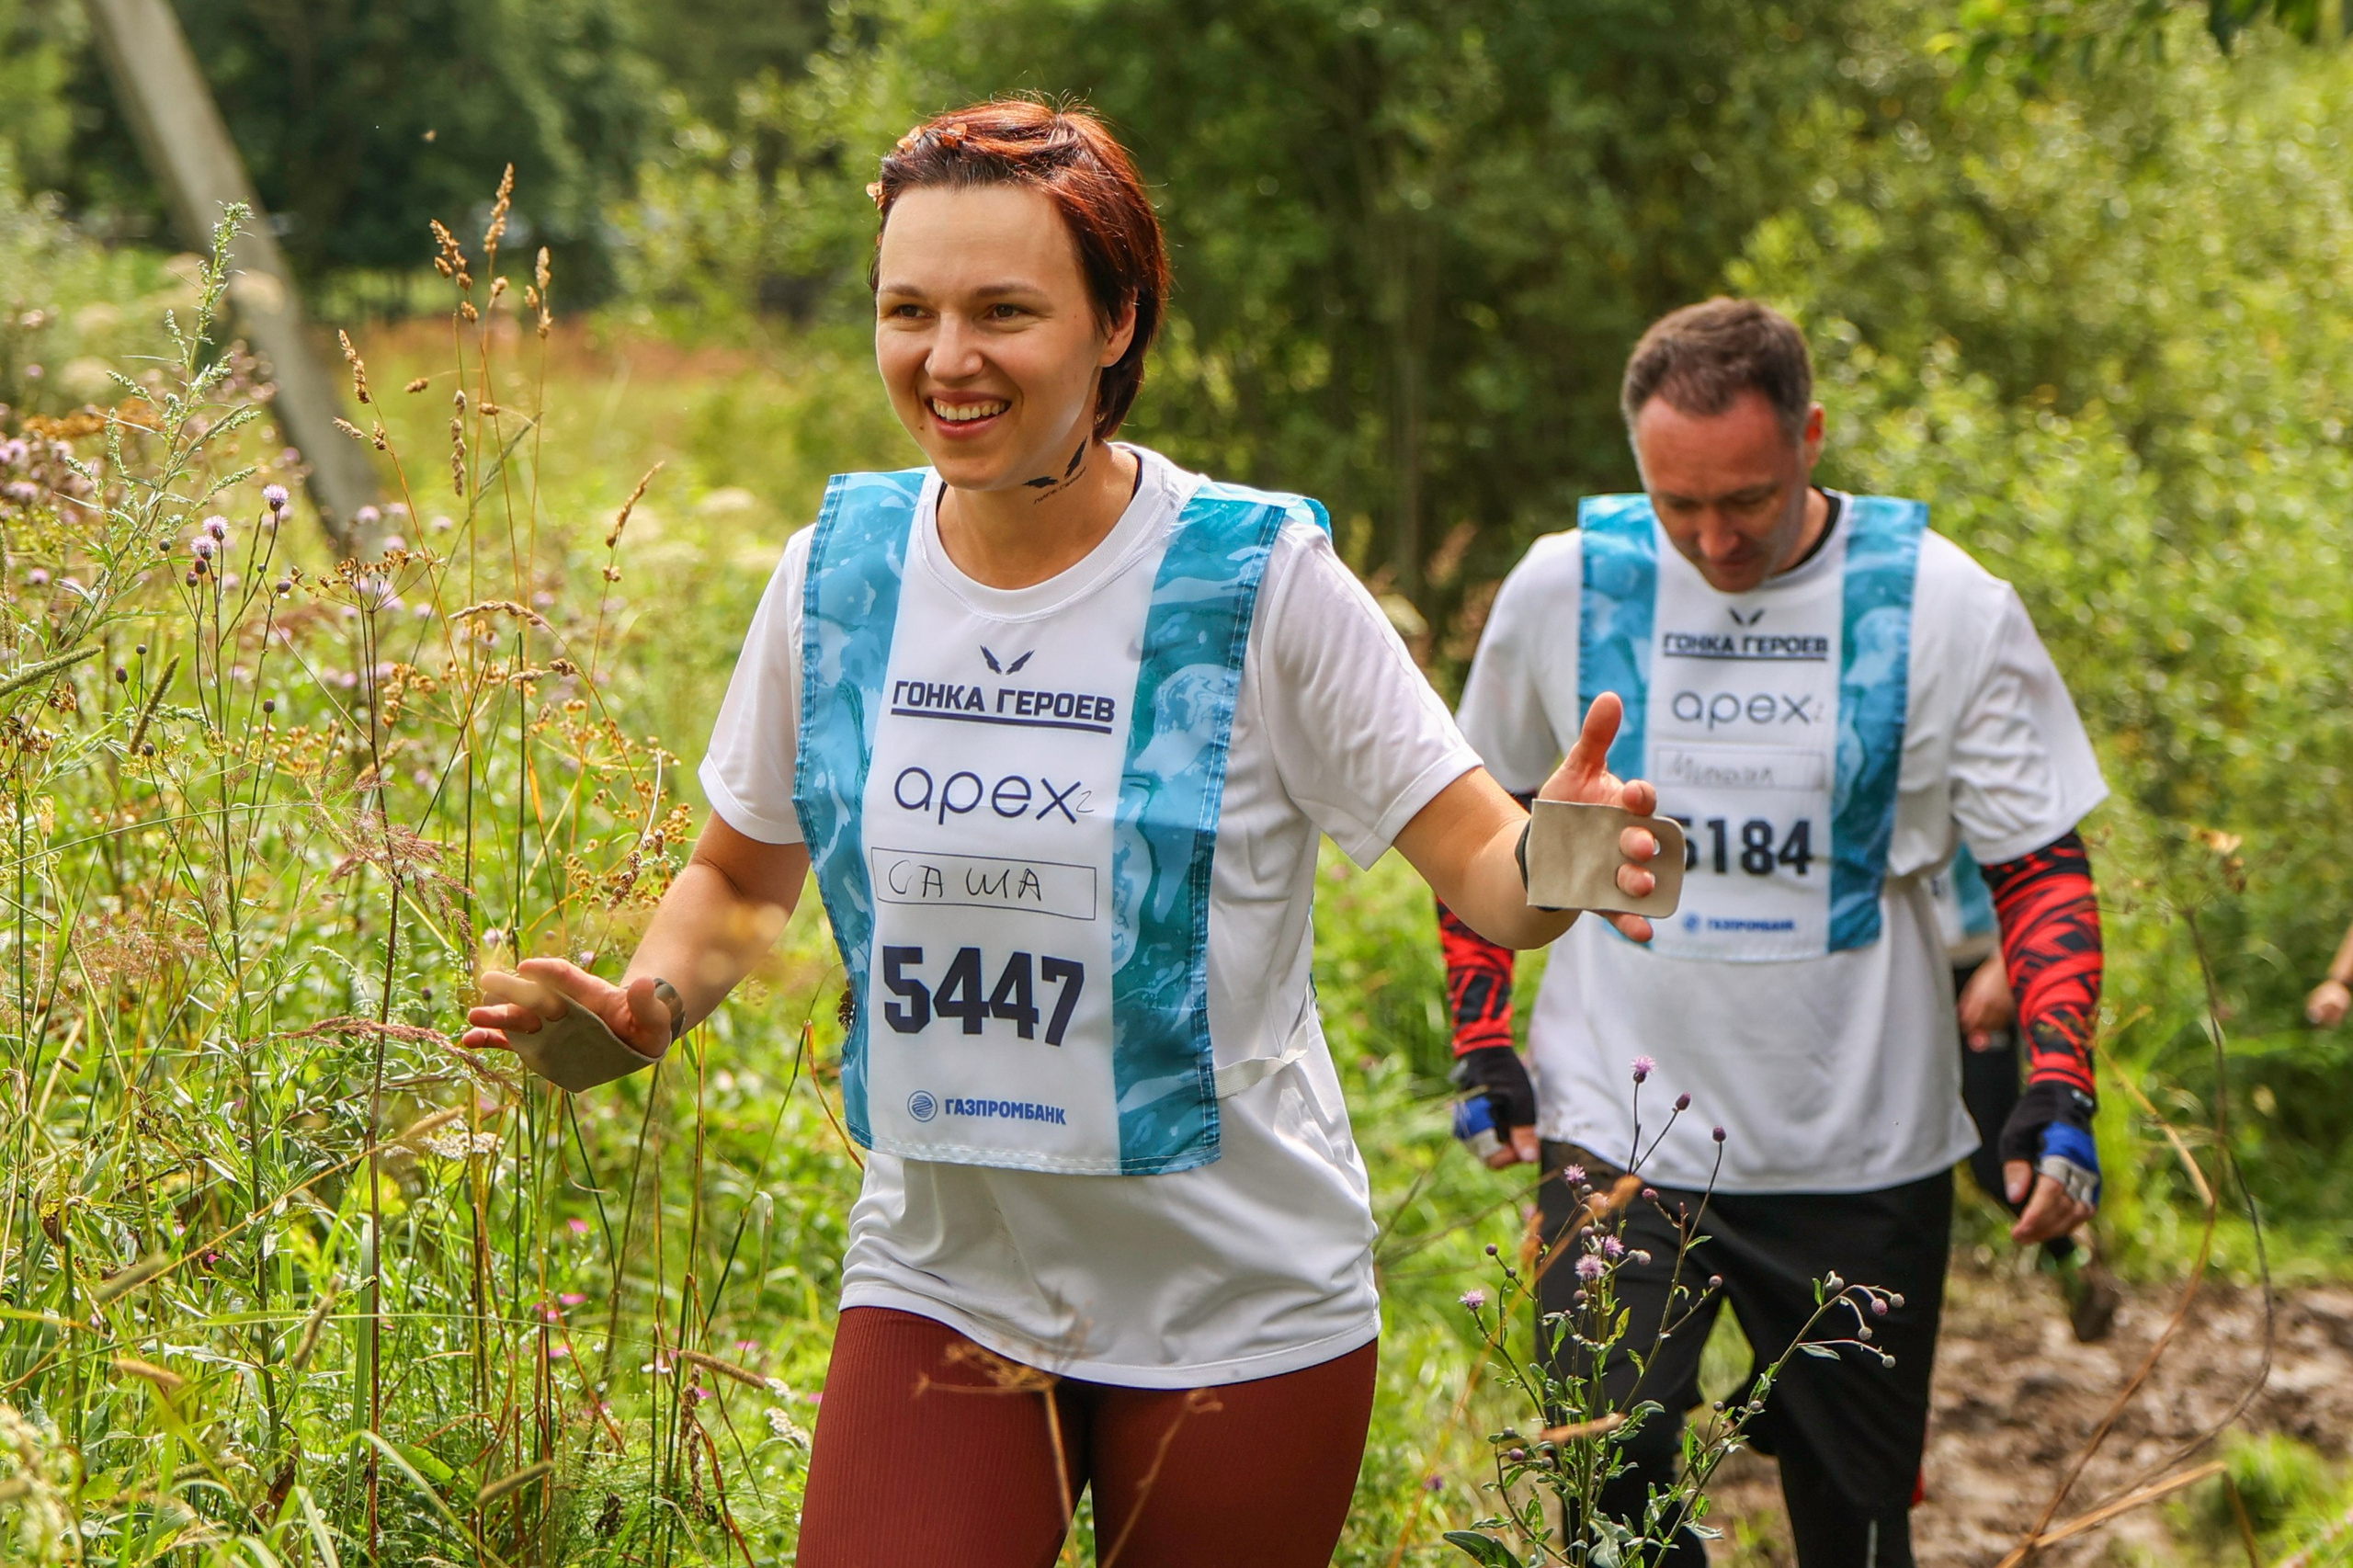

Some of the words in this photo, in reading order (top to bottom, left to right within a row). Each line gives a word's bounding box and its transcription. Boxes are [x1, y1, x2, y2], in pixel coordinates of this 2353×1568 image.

[1664, 632, 1734, 653] ГОНКА
[1743, 634, 1828, 653] ГЕРОЕВ
[892, 680, 985, 712] ГОНКА
[996, 687, 1116, 723] ГЕРОЕВ
[1672, 690, 1813, 732] apex
[893, 767, 1082, 825] apex
[888, 859, 1042, 902] САША
[882, 945, 1086, 1047] 5447
[944, 1098, 1067, 1126] ГАЗПРОМБАНК
